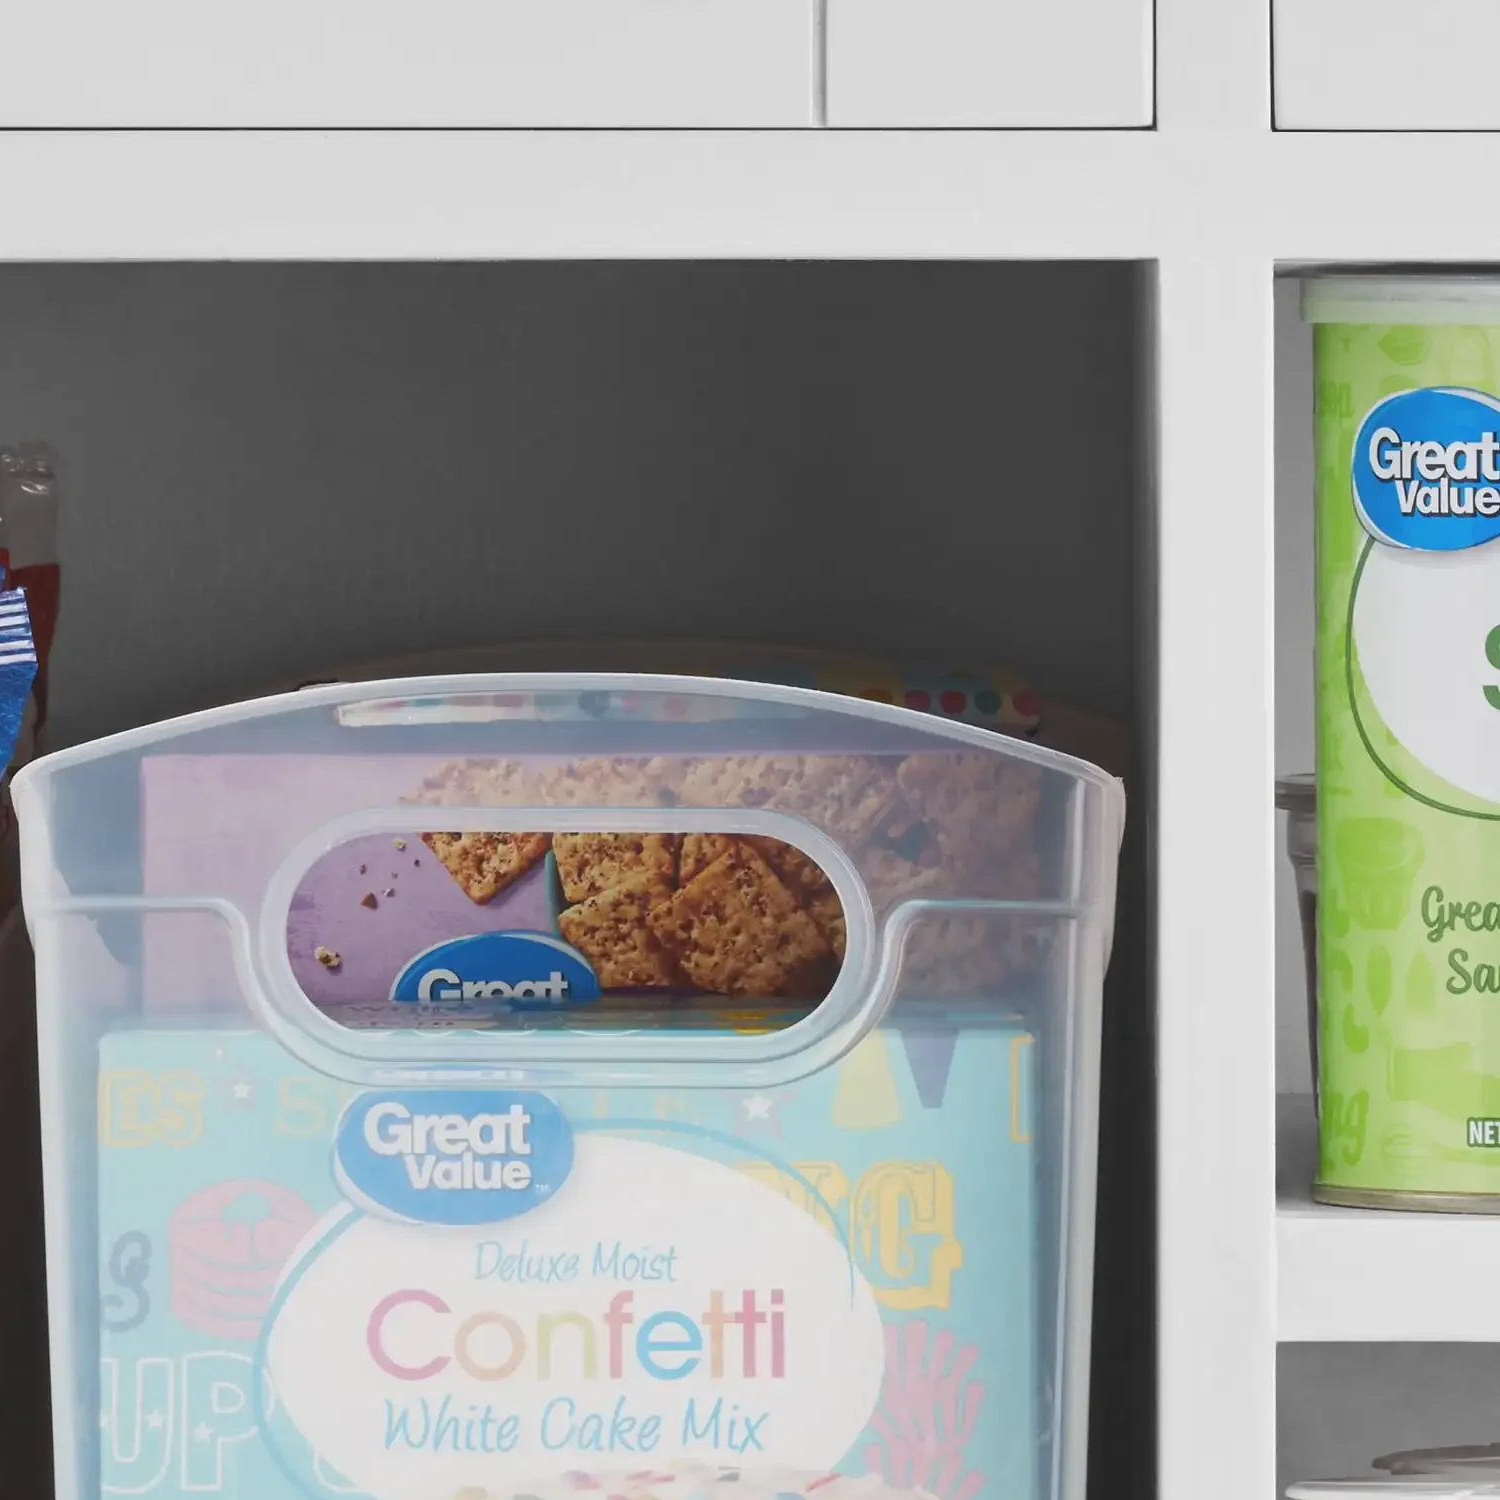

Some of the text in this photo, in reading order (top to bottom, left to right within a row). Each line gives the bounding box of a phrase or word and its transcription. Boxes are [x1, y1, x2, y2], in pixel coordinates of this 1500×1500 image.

[1369, 427, 1500, 480] Great
[1395, 477, 1500, 516] Value
[364, 1101, 532, 1156] Great
[405, 1153, 532, 1191] Value
[474, 1239, 678, 1283] Deluxe Moist
[366, 1288, 785, 1382] Confetti
[383, 1394, 771, 1455] White Cake Mix
